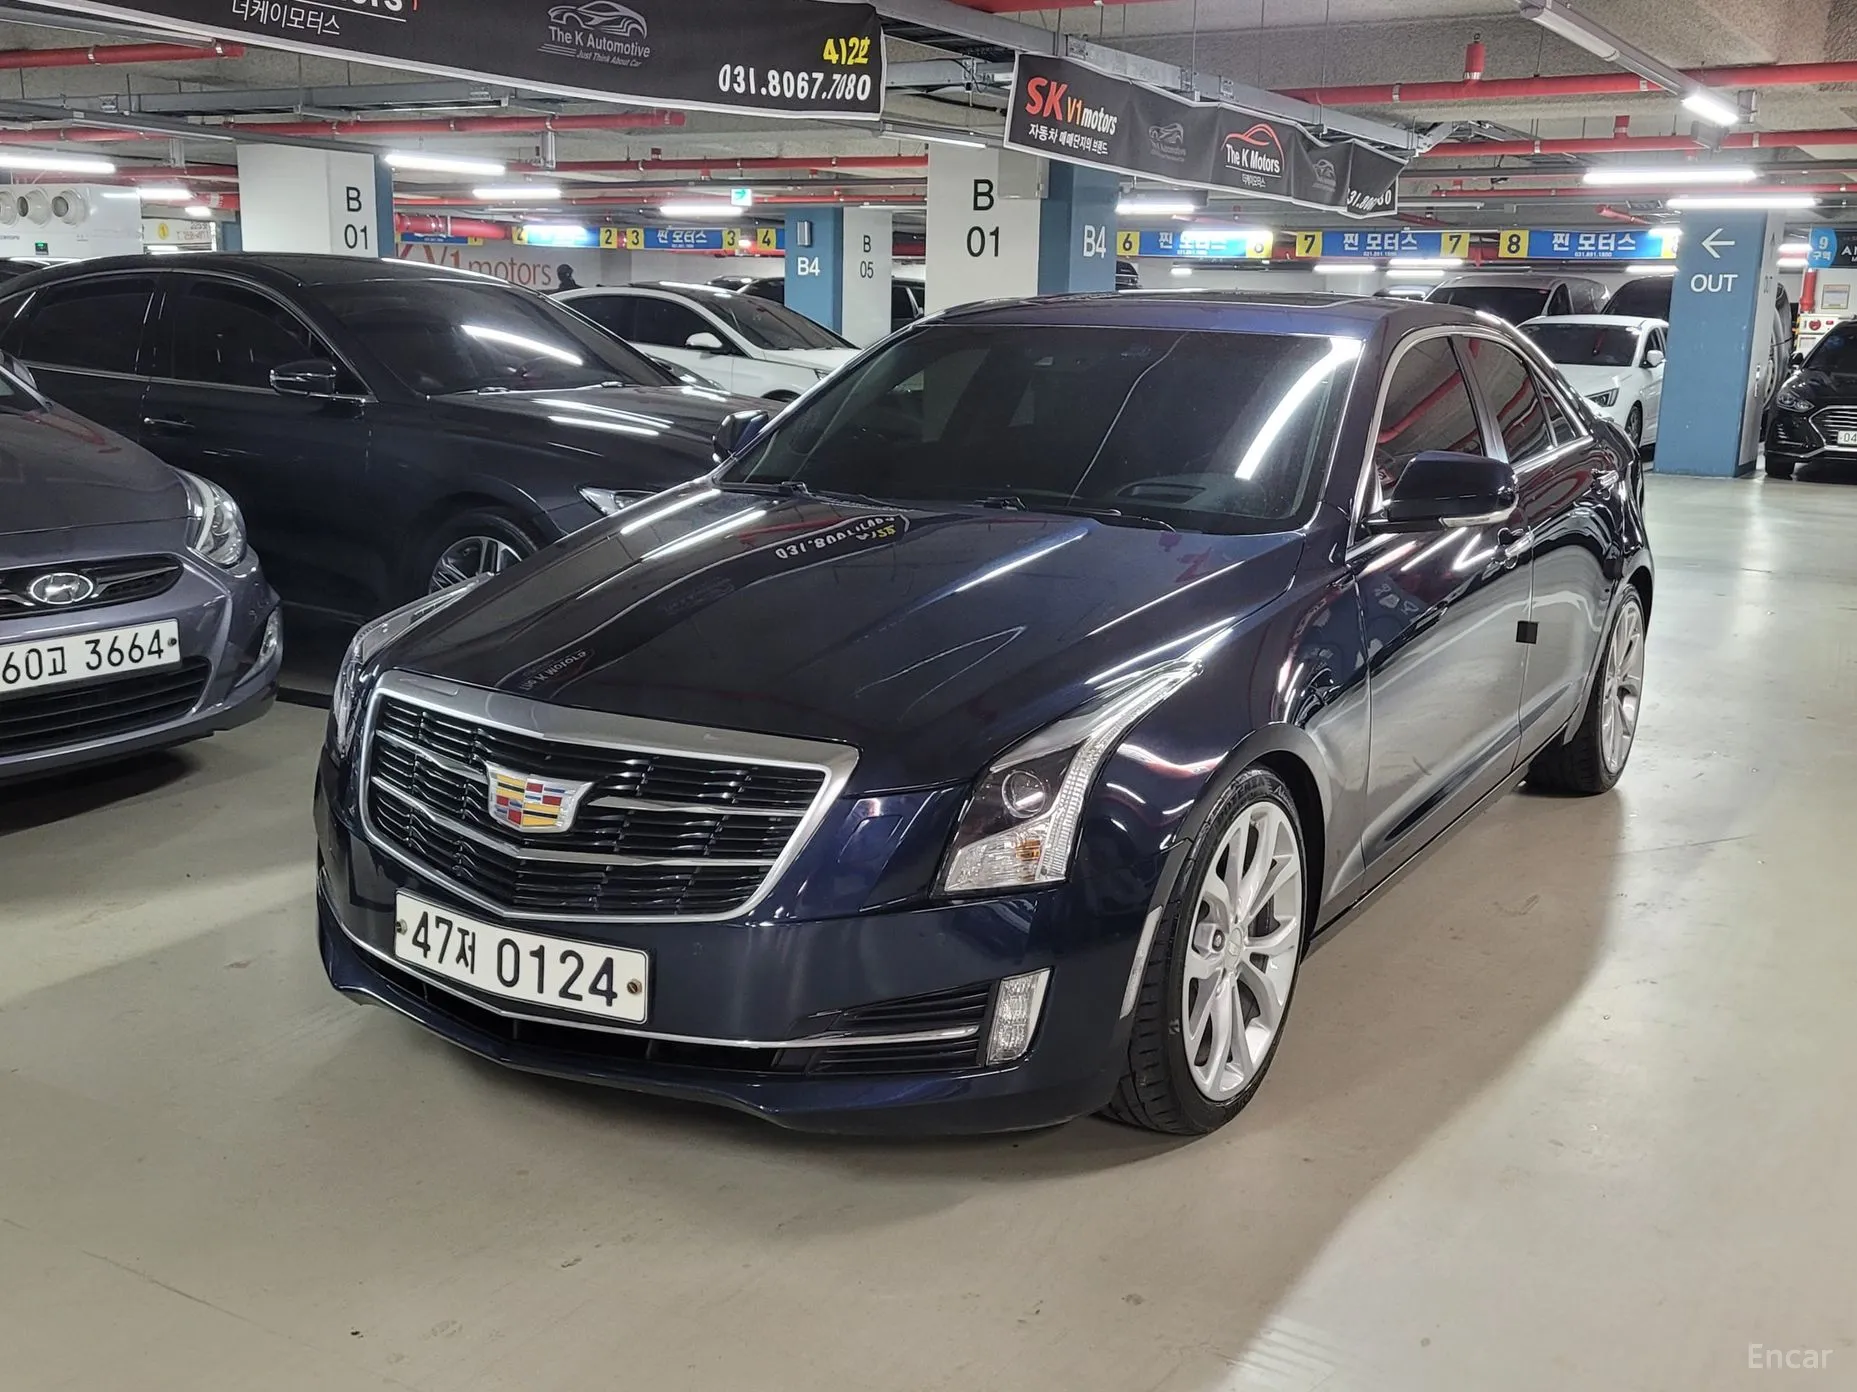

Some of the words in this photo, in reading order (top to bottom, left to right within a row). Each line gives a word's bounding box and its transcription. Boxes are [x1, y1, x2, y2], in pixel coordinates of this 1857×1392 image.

[548, 26, 573, 43] The
[575, 31, 584, 46] K
[587, 33, 651, 58] Automotive
[718, 63, 871, 100] 031.8067.7080
[1025, 77, 1068, 120] SK
[1028, 123, 1058, 143] 자동차
[1226, 144, 1240, 166] The
[1241, 148, 1249, 167] K
[1250, 151, 1281, 173] Motors
[346, 186, 362, 212] B
[973, 179, 995, 211] B
[344, 224, 368, 250] 01
[604, 229, 613, 245] 2
[631, 230, 640, 246] 3
[672, 230, 708, 244] 모터스
[726, 230, 736, 246] 3
[761, 230, 772, 246] 4
[863, 235, 872, 253] B
[966, 226, 1000, 257] 01
[1083, 225, 1107, 259] B4
[1122, 233, 1132, 251] 6
[1304, 235, 1315, 253] 7
[1343, 233, 1359, 250] 찐
[1366, 232, 1418, 250] 모터스
[1449, 235, 1461, 253] 7
[1507, 233, 1521, 254] 8
[1552, 233, 1569, 250] 찐
[1578, 233, 1636, 251] 모터스
[1819, 236, 1829, 249] 9
[469, 257, 551, 286] motors
[797, 256, 820, 276] B4
[860, 261, 874, 278] 05
[1690, 274, 1738, 292] OUT
[2, 645, 67, 684] 60고
[85, 629, 163, 671] 3664
[412, 911, 475, 975] 47저
[497, 938, 617, 1006] 0124
